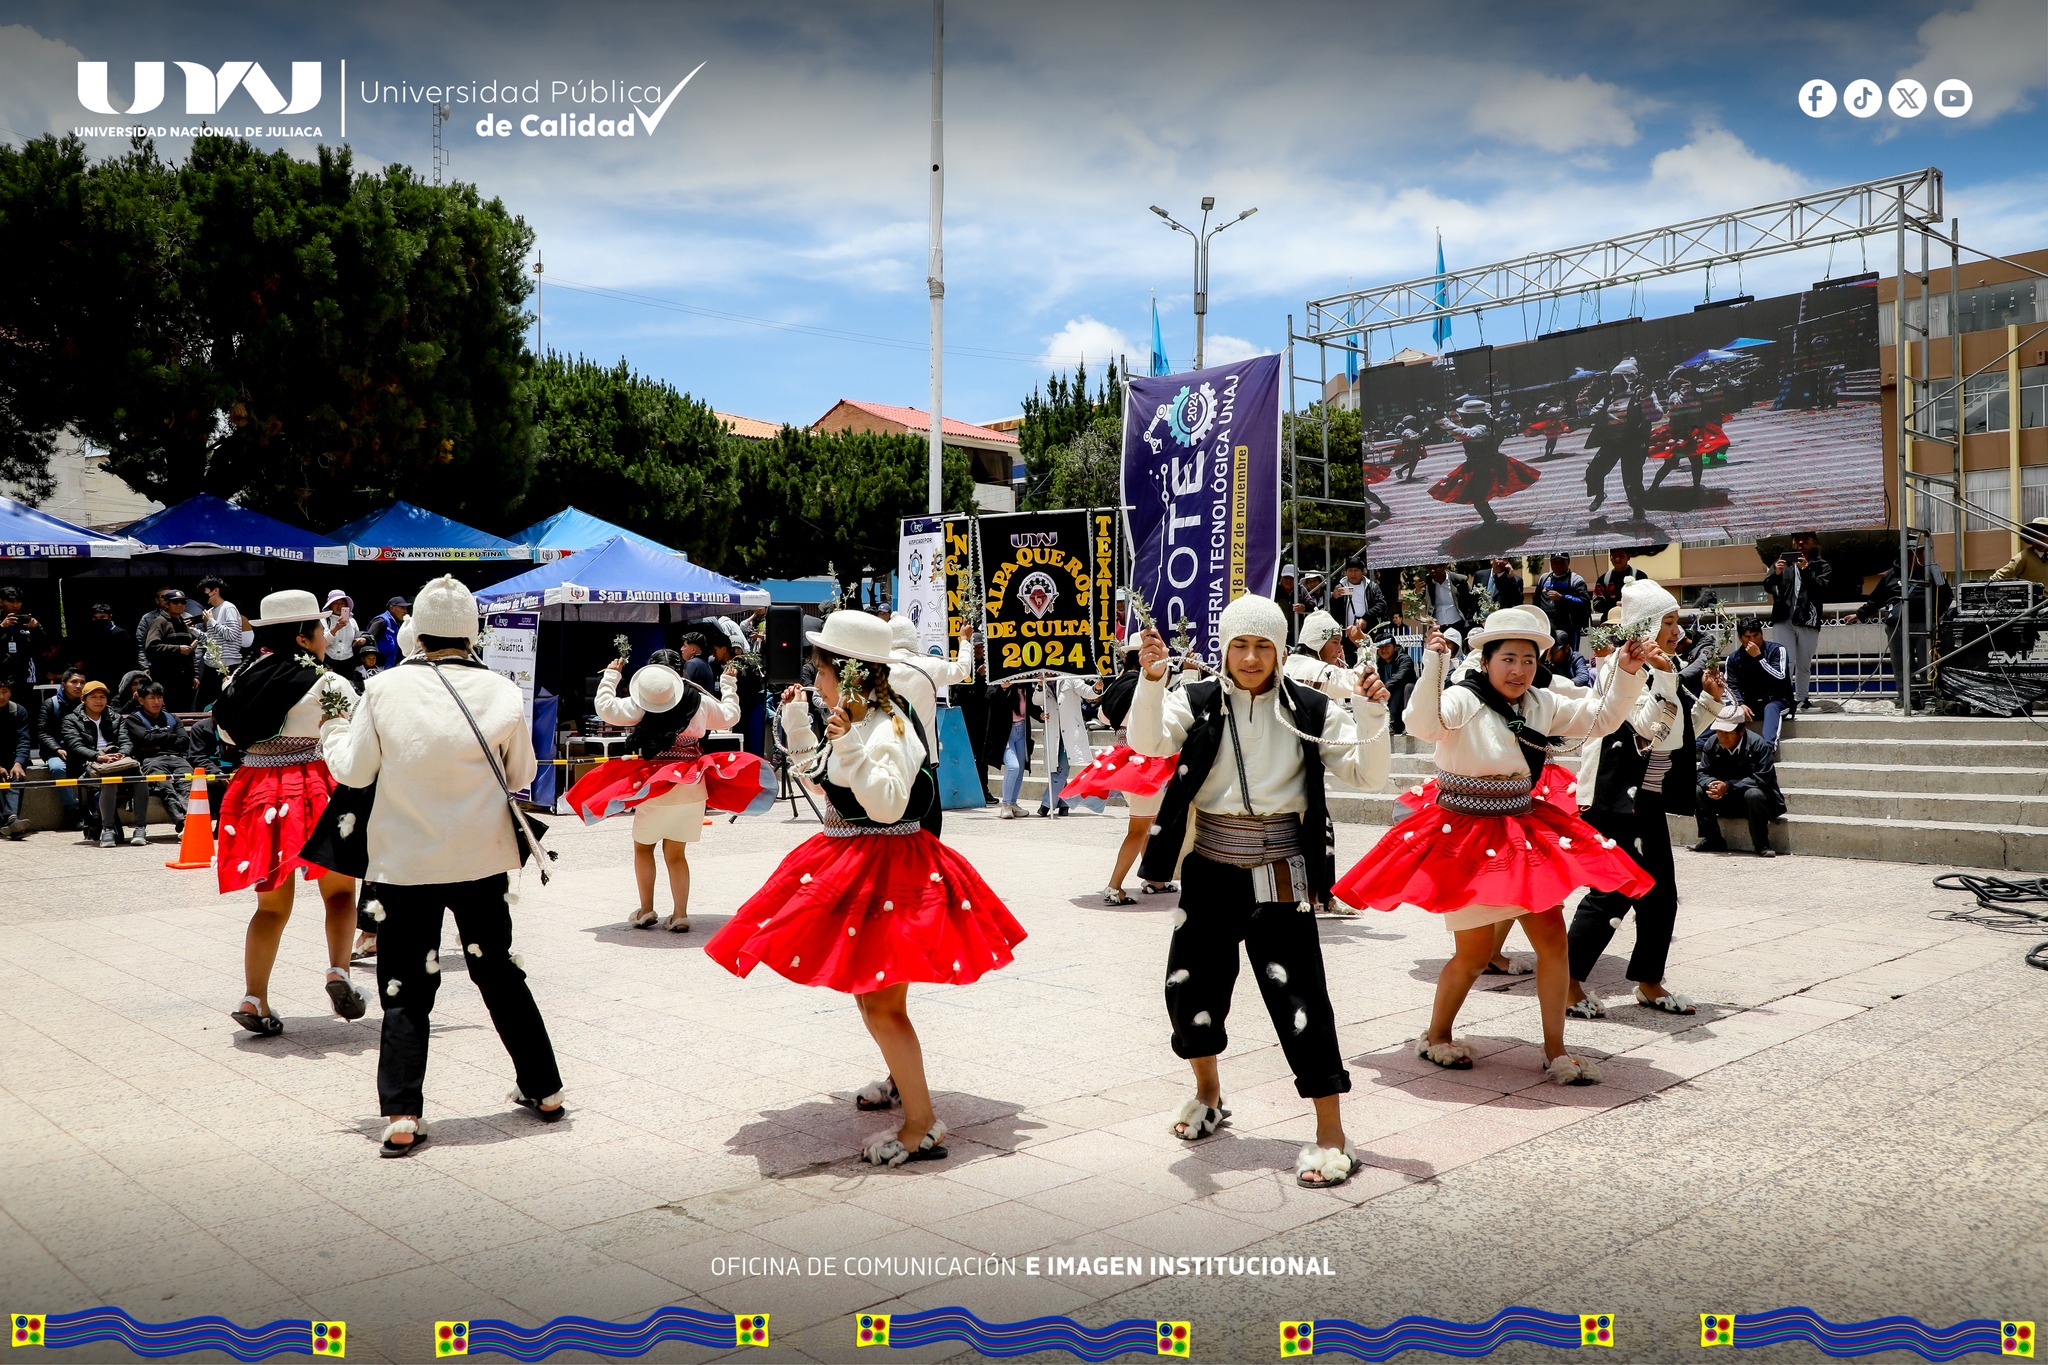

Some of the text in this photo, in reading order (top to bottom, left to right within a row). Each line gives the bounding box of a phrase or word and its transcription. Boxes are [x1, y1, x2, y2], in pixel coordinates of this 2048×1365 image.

[1187, 392, 1200, 422] 2024
[1219, 375, 1240, 425] UNAJ
[1209, 429, 1231, 574] TECNOLÓGICA
[1231, 448, 1247, 595] 18 al 22 de noviembre
[6, 544, 77, 556] de Putina
[264, 546, 304, 560] Putina
[1095, 515, 1114, 641] TEXTIL
[520, 596, 539, 607] Putina
[598, 589, 731, 602] San Antonio de Putina
[986, 619, 1090, 639] DE CULTA
[1002, 641, 1085, 669] 2024
